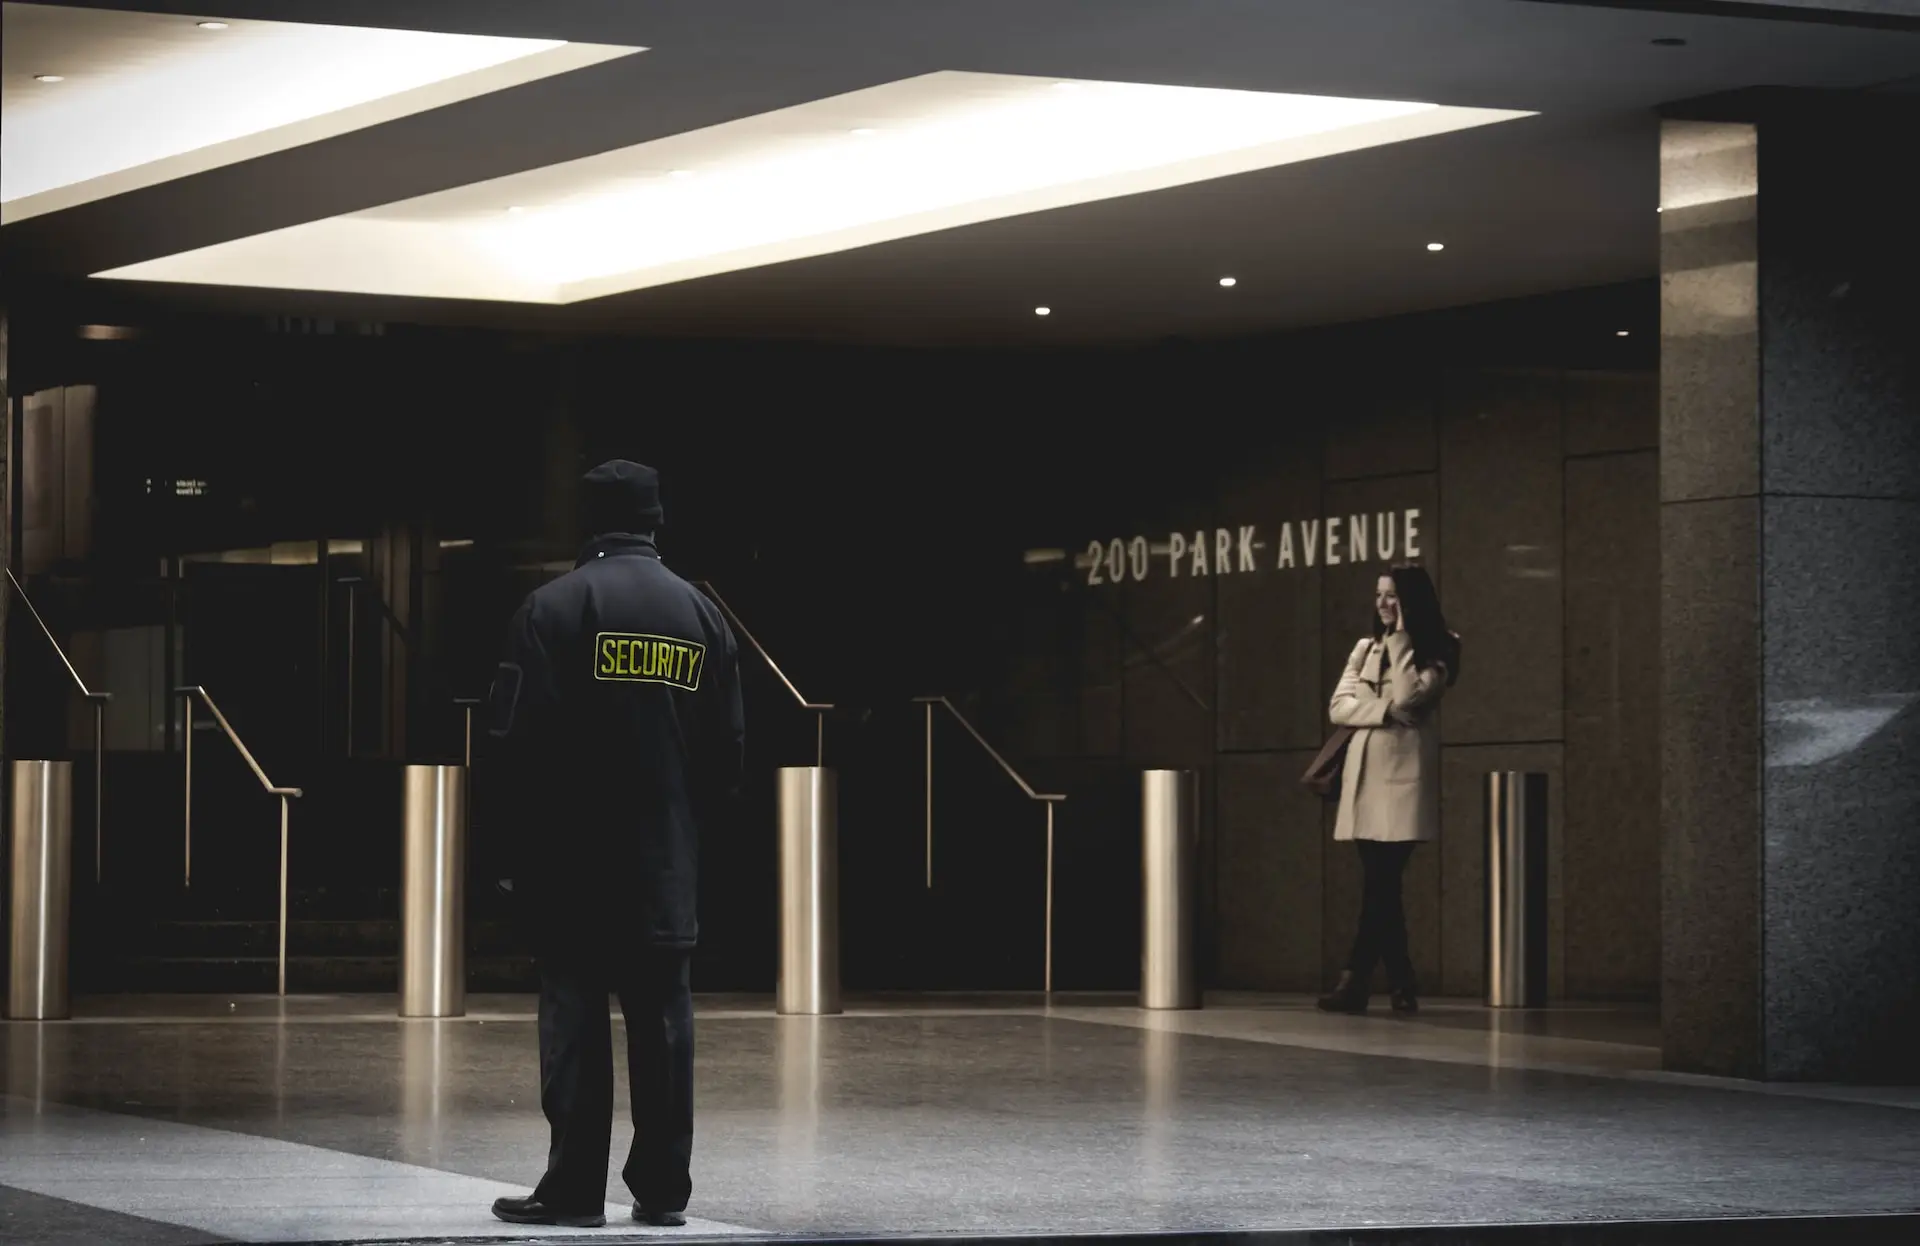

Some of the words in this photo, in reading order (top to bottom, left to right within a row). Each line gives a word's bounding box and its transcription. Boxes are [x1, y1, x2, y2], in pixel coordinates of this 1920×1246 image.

[1087, 536, 1149, 585] 200
[1169, 525, 1257, 578] PARK
[1277, 508, 1421, 570] AVENUE
[601, 639, 701, 684] SECURITY
